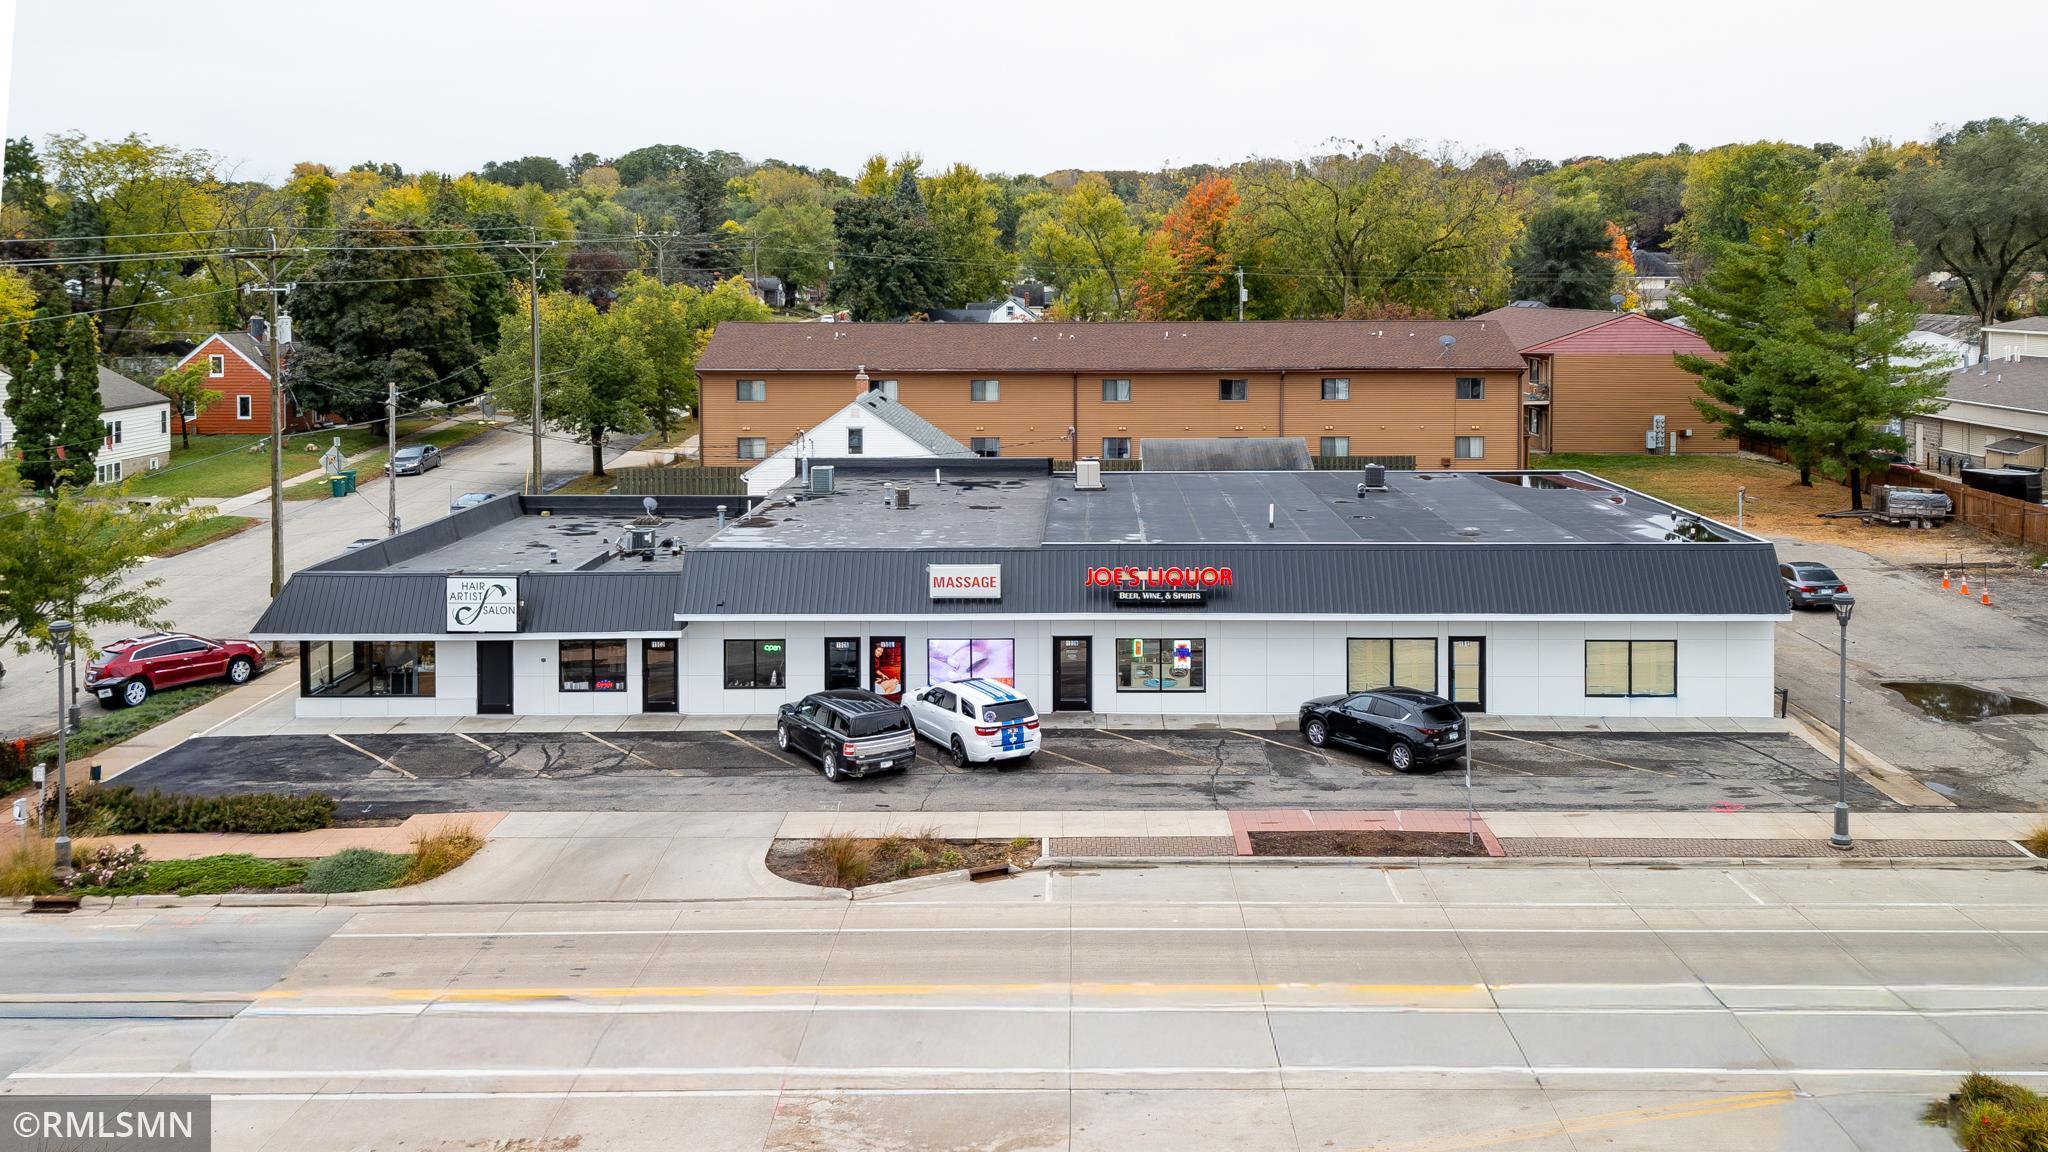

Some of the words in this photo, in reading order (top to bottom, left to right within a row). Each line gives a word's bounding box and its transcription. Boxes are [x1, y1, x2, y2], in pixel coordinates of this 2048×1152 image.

[1085, 565, 1141, 586] JOE'S
[1147, 566, 1233, 587] LIQUOR
[461, 582, 485, 591] HAIR
[933, 576, 997, 588] MASSAGE
[449, 592, 483, 601] ARTIST
[482, 605, 516, 615] SALON
